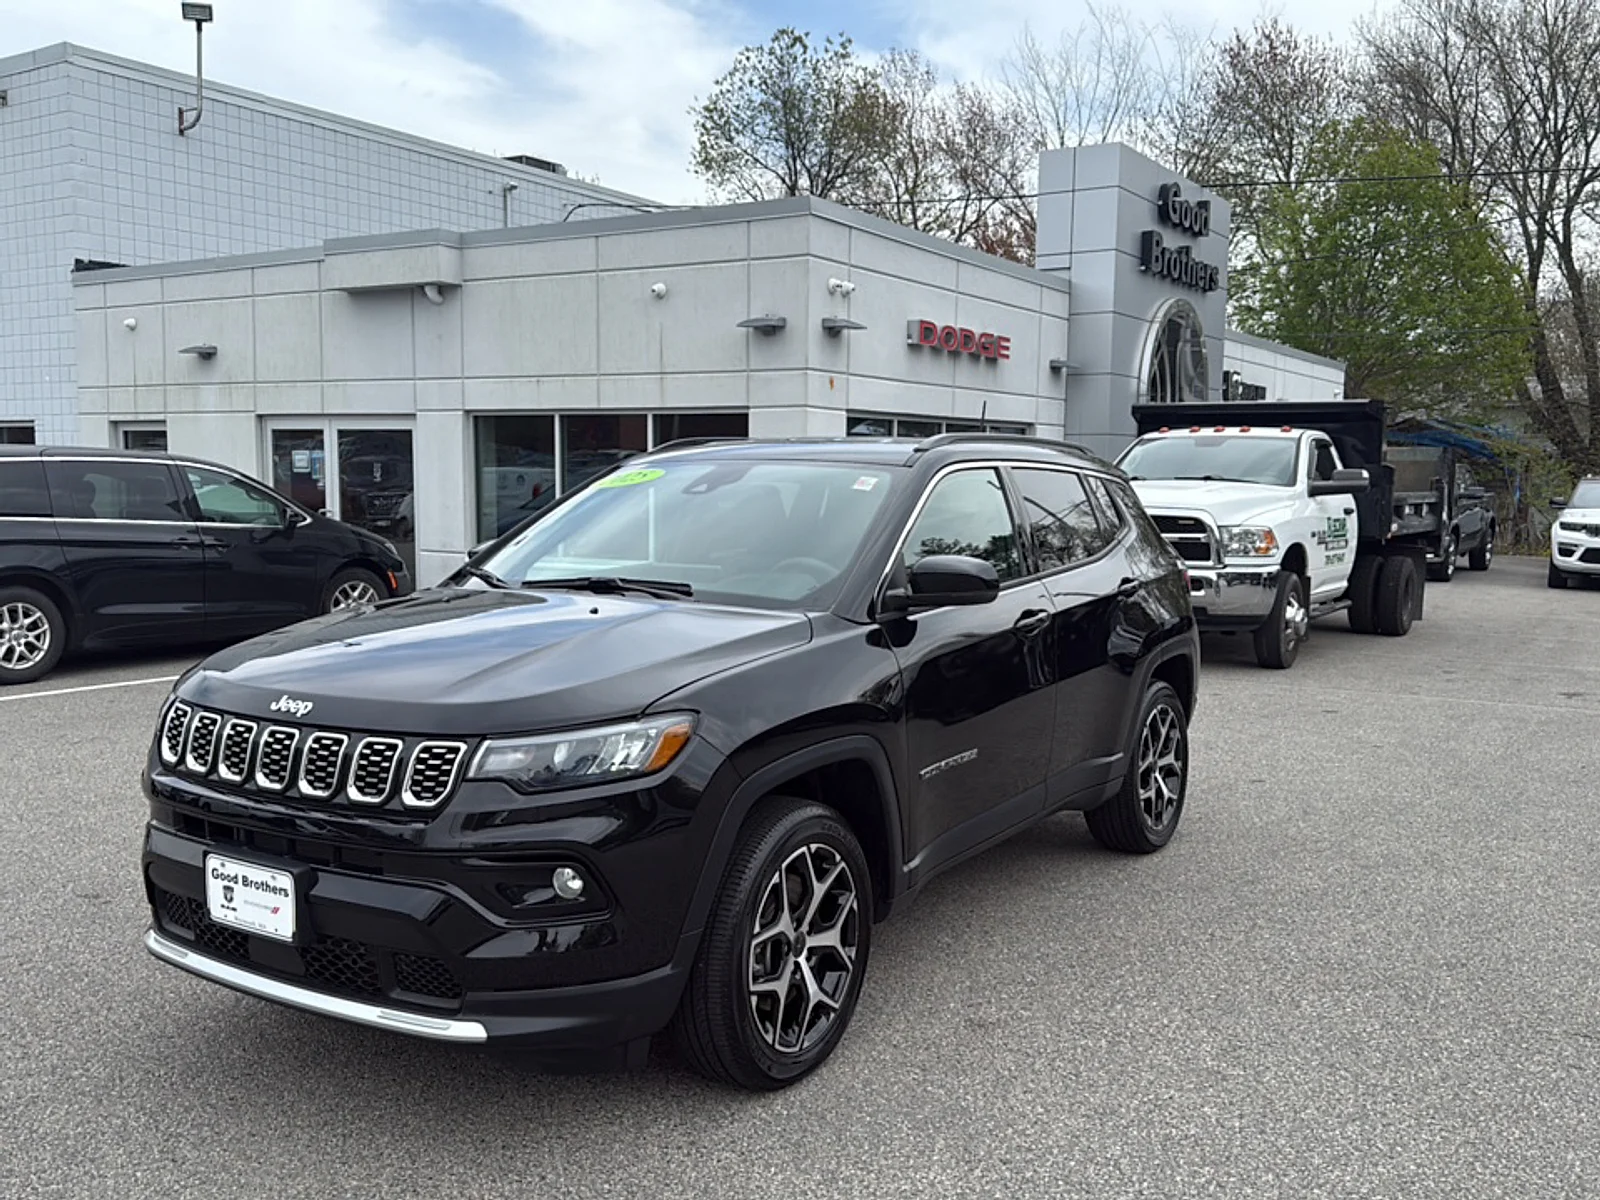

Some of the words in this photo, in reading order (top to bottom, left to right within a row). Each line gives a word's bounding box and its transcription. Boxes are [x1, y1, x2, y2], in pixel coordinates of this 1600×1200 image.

[1164, 182, 1211, 237] Good
[1148, 230, 1219, 292] Brothers
[916, 319, 1011, 360] DODGE
[270, 694, 313, 718] Jeep
[211, 867, 239, 885] Good
[241, 875, 289, 898] Brothers
